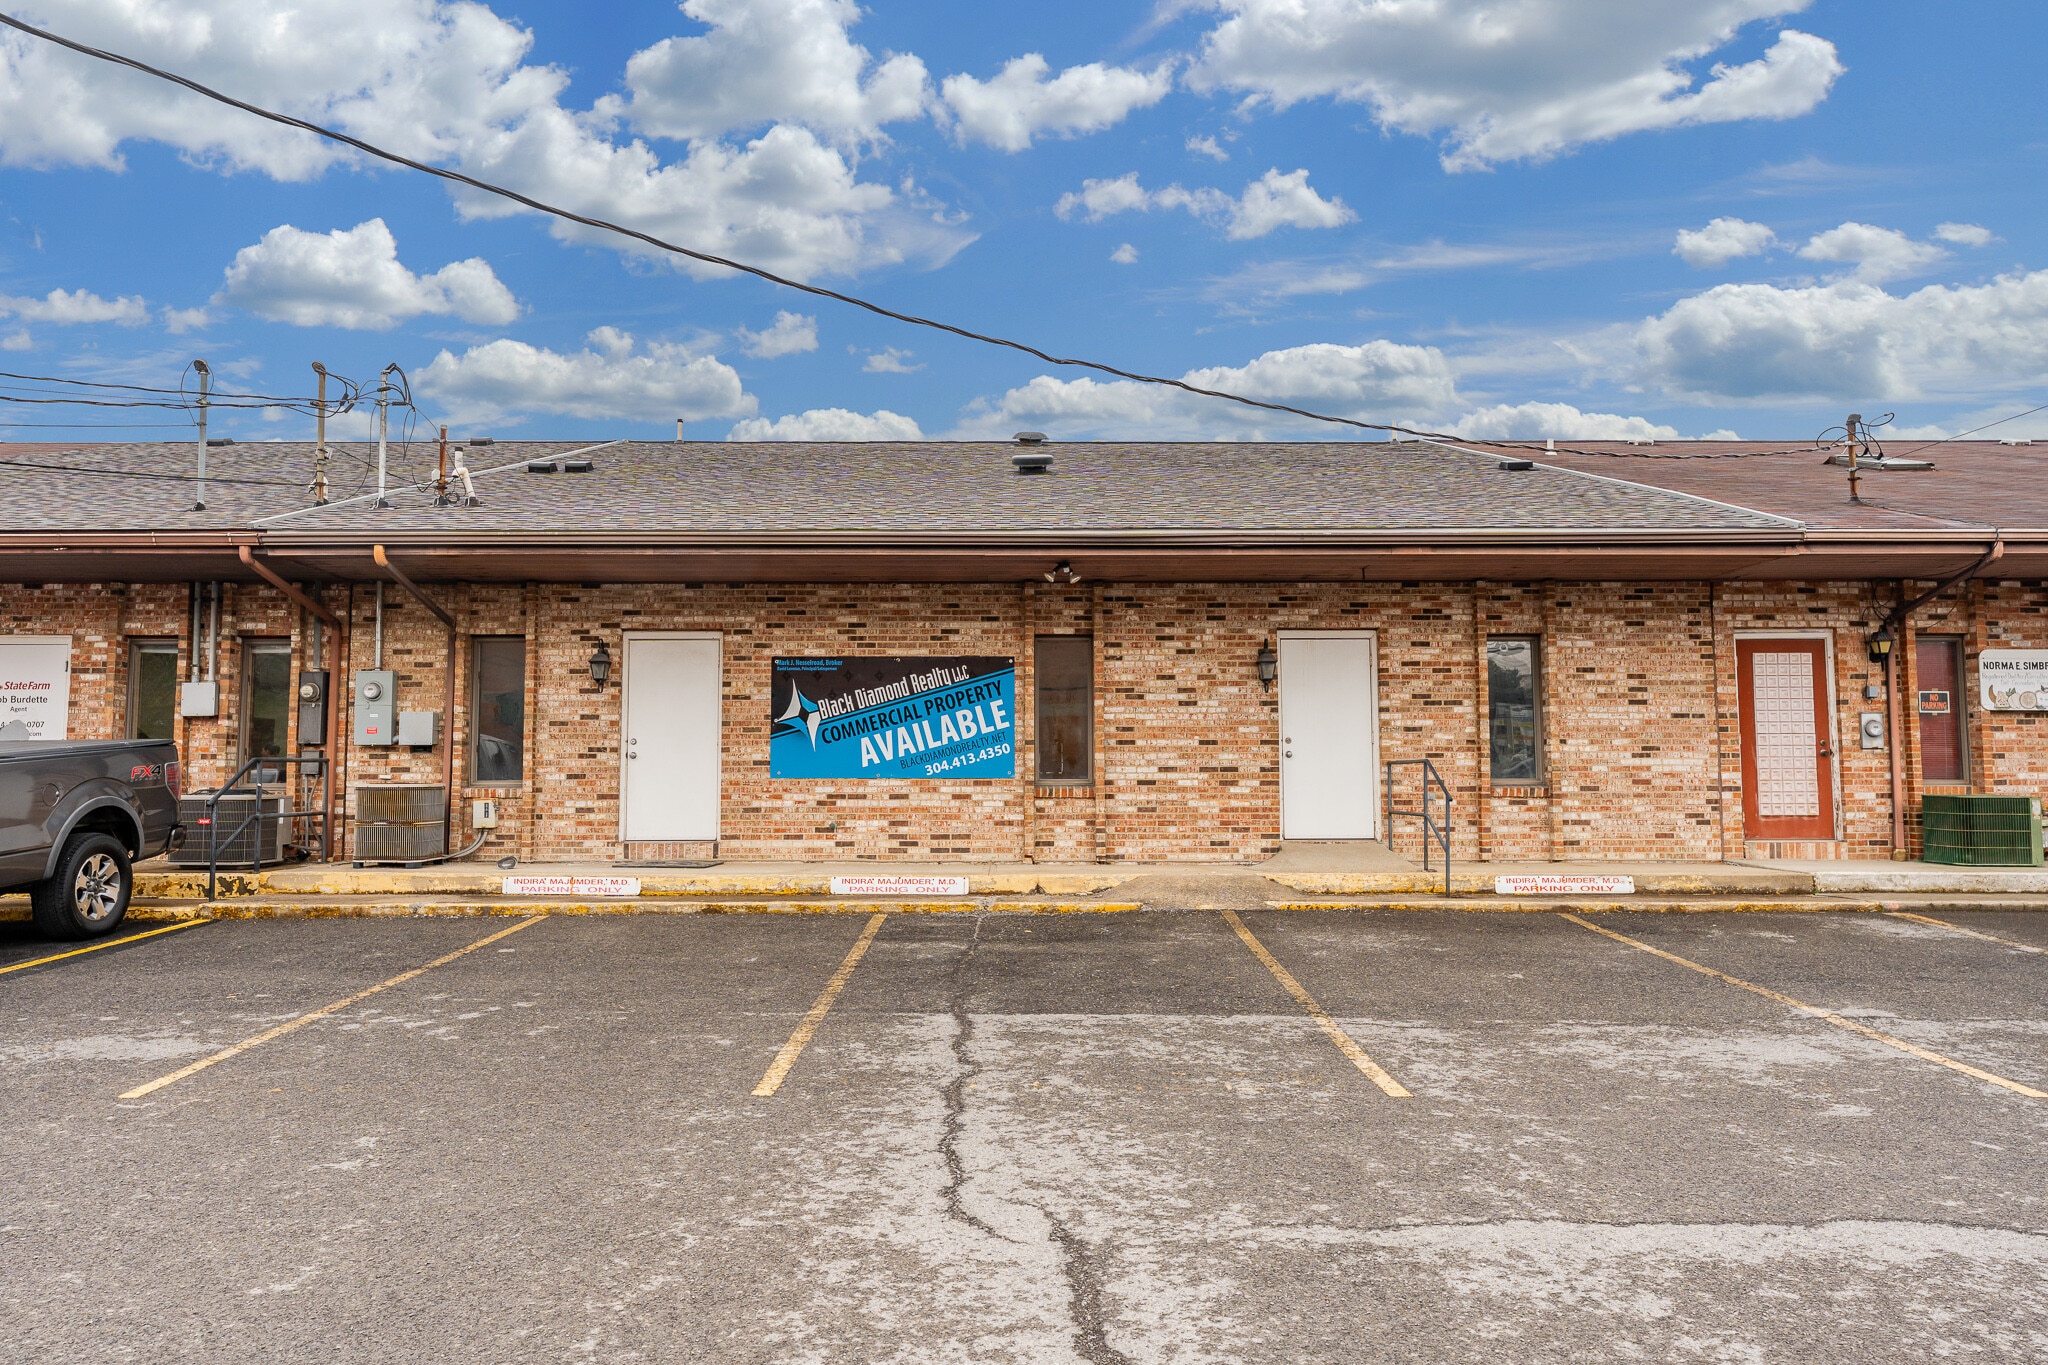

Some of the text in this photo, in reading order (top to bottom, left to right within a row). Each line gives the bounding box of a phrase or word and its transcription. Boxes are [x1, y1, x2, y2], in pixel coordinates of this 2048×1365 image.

[1983, 661, 2014, 670] NORMA
[2016, 662, 2022, 670] E.
[10, 695, 48, 703] Burdette
[817, 665, 970, 720] Black Diamond Realty LLC
[1922, 702, 1947, 710] PARKING
[821, 680, 1002, 744] COMMERCIAL PROPERTY
[861, 699, 1010, 768] AVAILABLE
[900, 731, 1007, 769] BLACKDIAMONDREALTY.NET
[131, 764, 162, 779] FX4
[925, 743, 1011, 776] 304.413.4350
